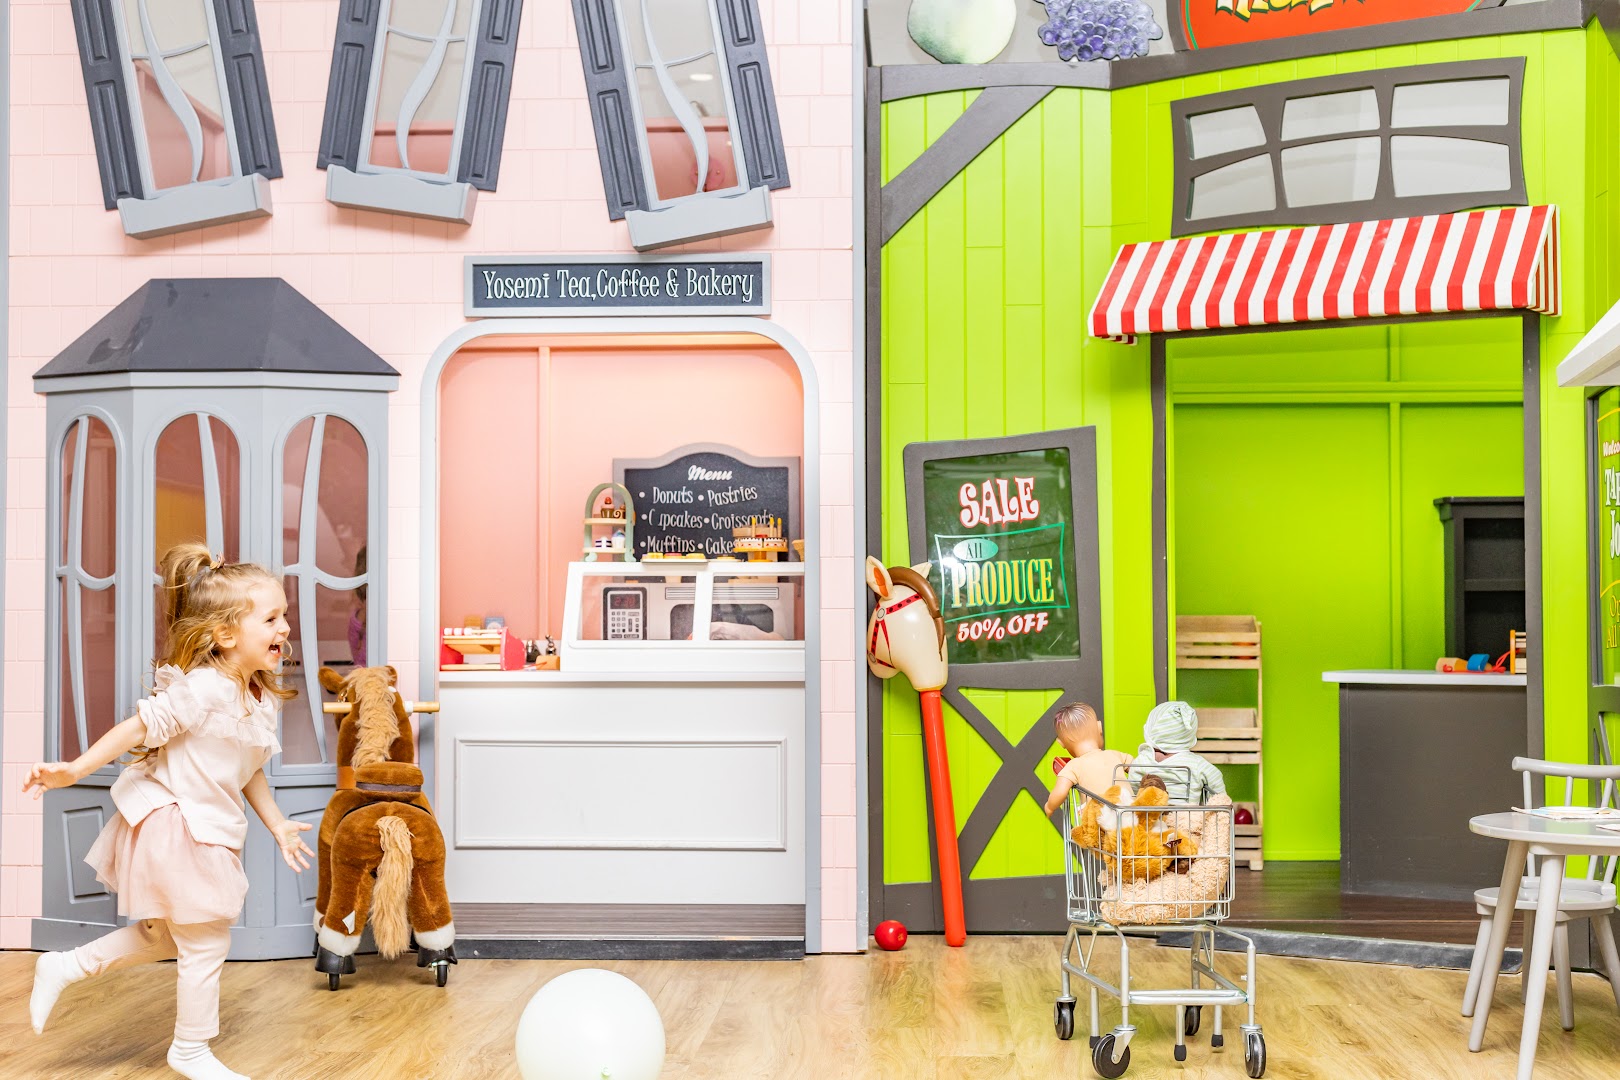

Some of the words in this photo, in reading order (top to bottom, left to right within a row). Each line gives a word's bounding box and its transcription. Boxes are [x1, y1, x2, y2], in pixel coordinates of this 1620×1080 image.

[482, 270, 550, 299] Yosemi
[665, 268, 680, 298] &
[685, 267, 754, 303] Bakery
[688, 464, 733, 481] Menu
[652, 486, 694, 504] Donuts
[707, 486, 758, 507] Pastries
[959, 475, 1041, 528] SALE
[647, 535, 695, 554] Muffins
[965, 542, 983, 559] All
[951, 558, 1055, 608] PRODUCE
[956, 617, 1005, 642] 50%
[1006, 612, 1049, 636] OFF
